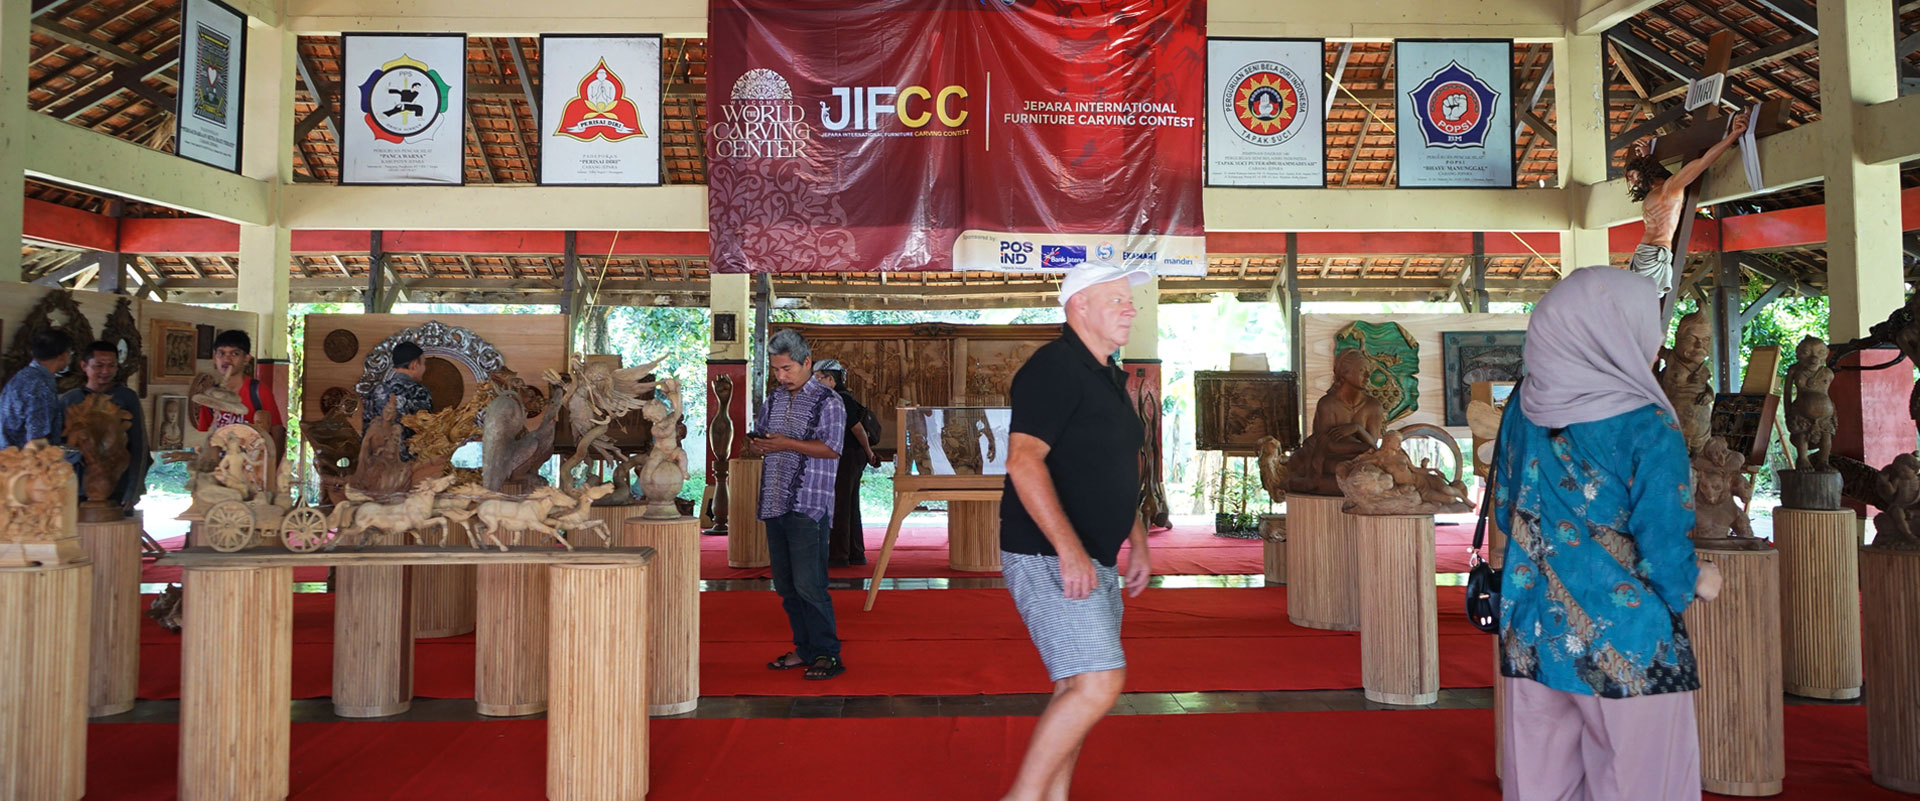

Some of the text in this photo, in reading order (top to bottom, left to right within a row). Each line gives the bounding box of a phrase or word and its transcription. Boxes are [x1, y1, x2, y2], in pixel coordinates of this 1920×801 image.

[1226, 63, 1306, 113] PERGURUAN SENI BELA DIRI INDONESIA
[720, 105, 805, 123] WORLD
[820, 85, 968, 130] JIFCC
[1023, 101, 1177, 114] JEPARA INTERNATIONAL
[1003, 114, 1195, 128] FURNITURE CARVING CONTEST
[1437, 119, 1473, 133] POPSI
[713, 121, 810, 140] CARVING
[943, 129, 969, 137] CONTEST
[1241, 130, 1292, 144] TAPAK SUCI
[716, 139, 807, 158] CENTER
[1000, 241, 1034, 253] POS
